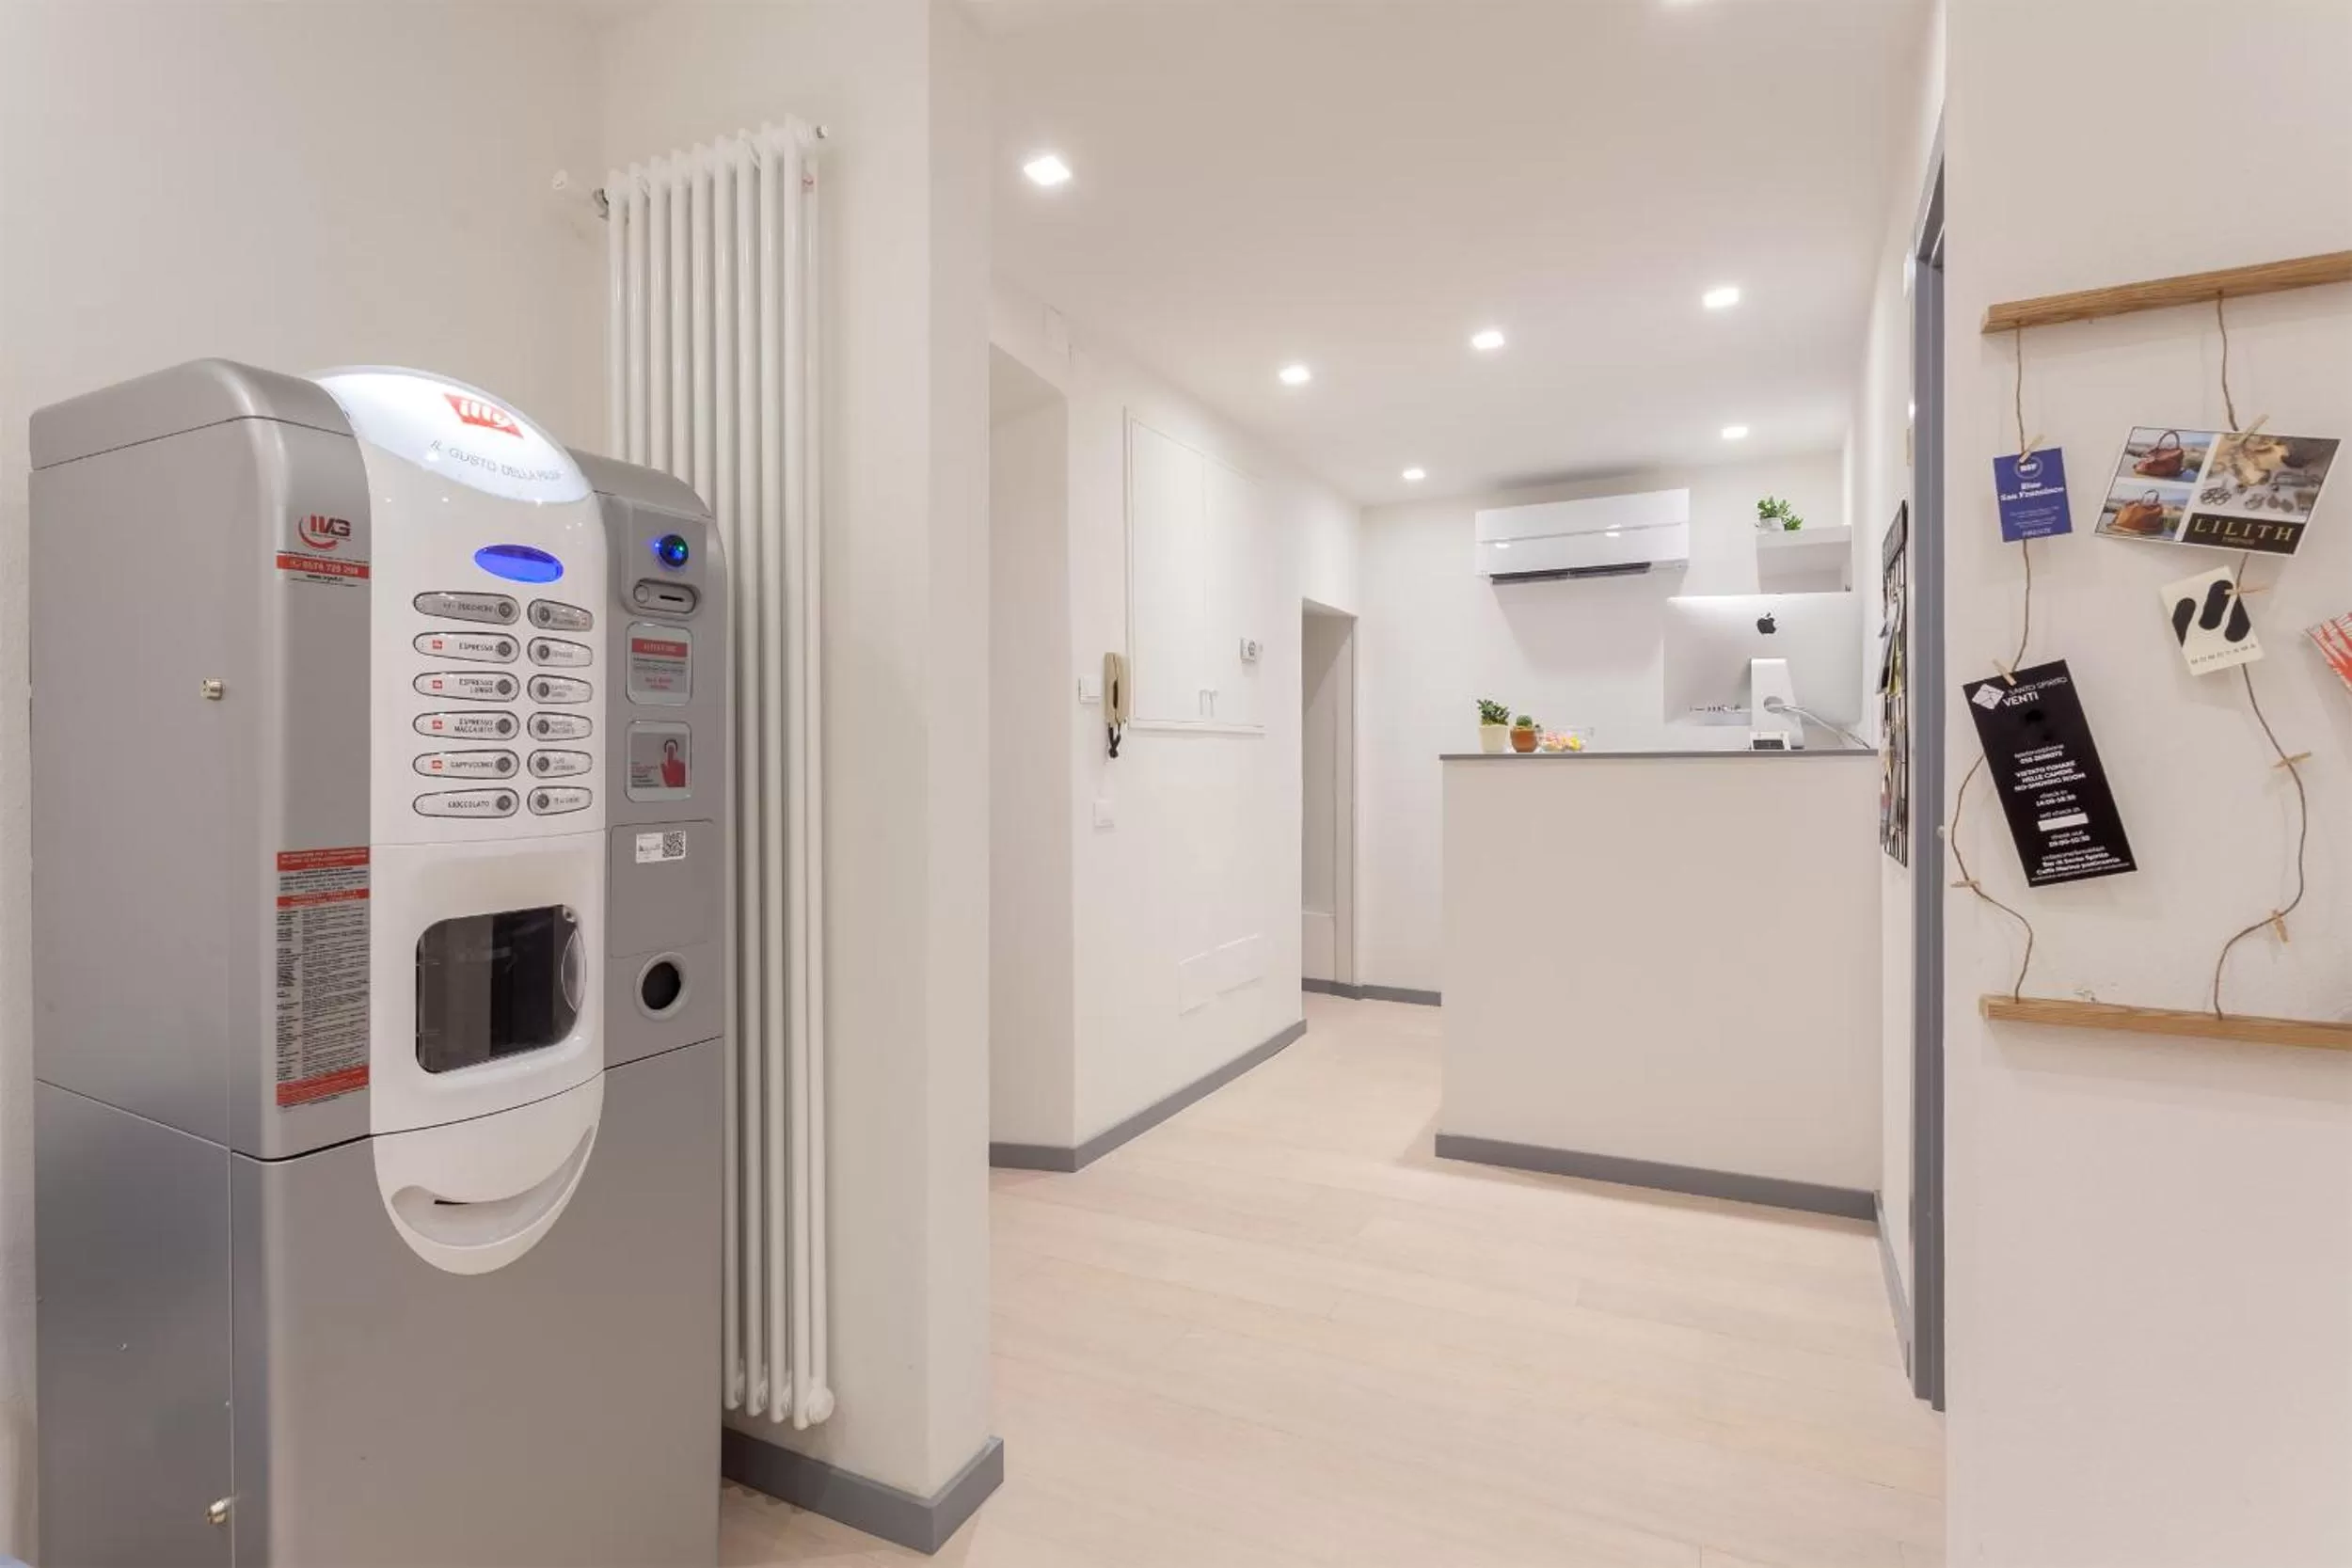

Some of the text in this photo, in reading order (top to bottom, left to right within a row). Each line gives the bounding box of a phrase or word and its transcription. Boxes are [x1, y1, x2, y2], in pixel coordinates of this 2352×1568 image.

[2194, 518, 2295, 542] LILITH
[458, 642, 494, 651] ESPRESSO
[2002, 691, 2040, 706] VENTI
